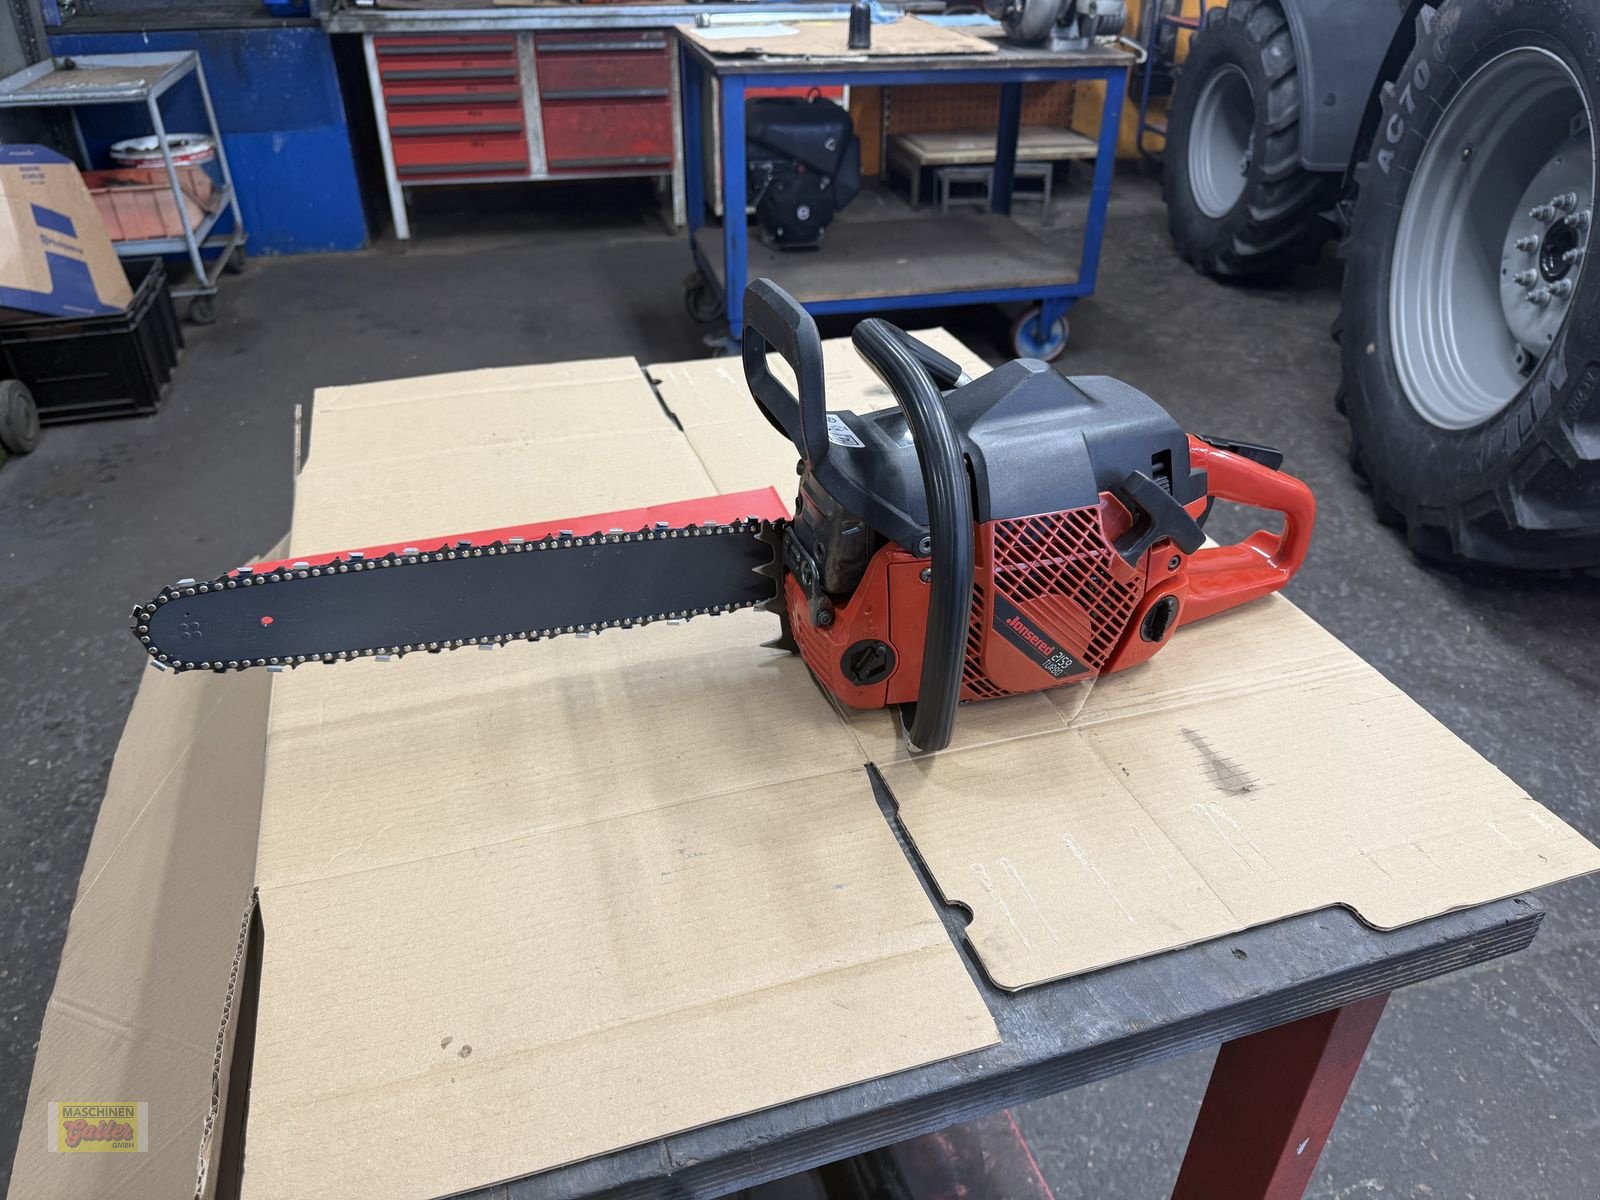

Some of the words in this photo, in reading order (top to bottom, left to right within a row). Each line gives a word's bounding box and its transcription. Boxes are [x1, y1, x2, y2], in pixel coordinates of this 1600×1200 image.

[1006, 616, 1056, 656] Jonsered
[1042, 659, 1064, 676] TURBO
[1051, 652, 1073, 669] 2159
